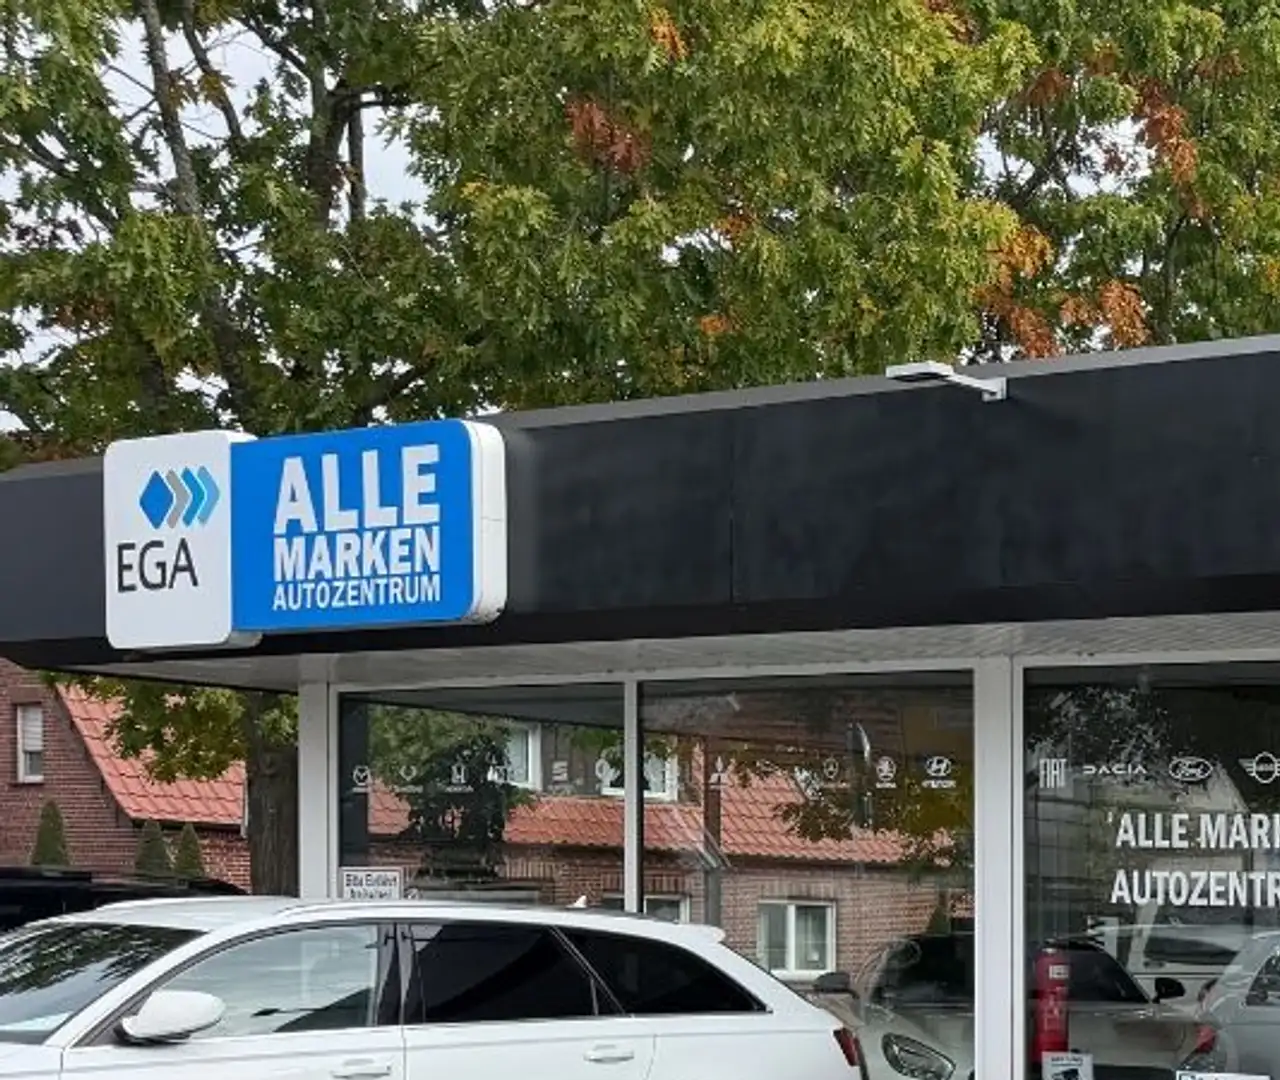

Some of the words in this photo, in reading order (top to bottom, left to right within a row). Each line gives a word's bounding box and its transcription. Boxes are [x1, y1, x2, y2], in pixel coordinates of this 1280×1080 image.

[274, 444, 440, 535] ALLE
[117, 538, 198, 592] EGA
[273, 526, 440, 583] MARKEN
[273, 574, 441, 612] AUTOZENTRUM
[1039, 758, 1067, 788] FIAT
[1083, 764, 1148, 775] DACIA
[1116, 813, 1190, 849] ALLE
